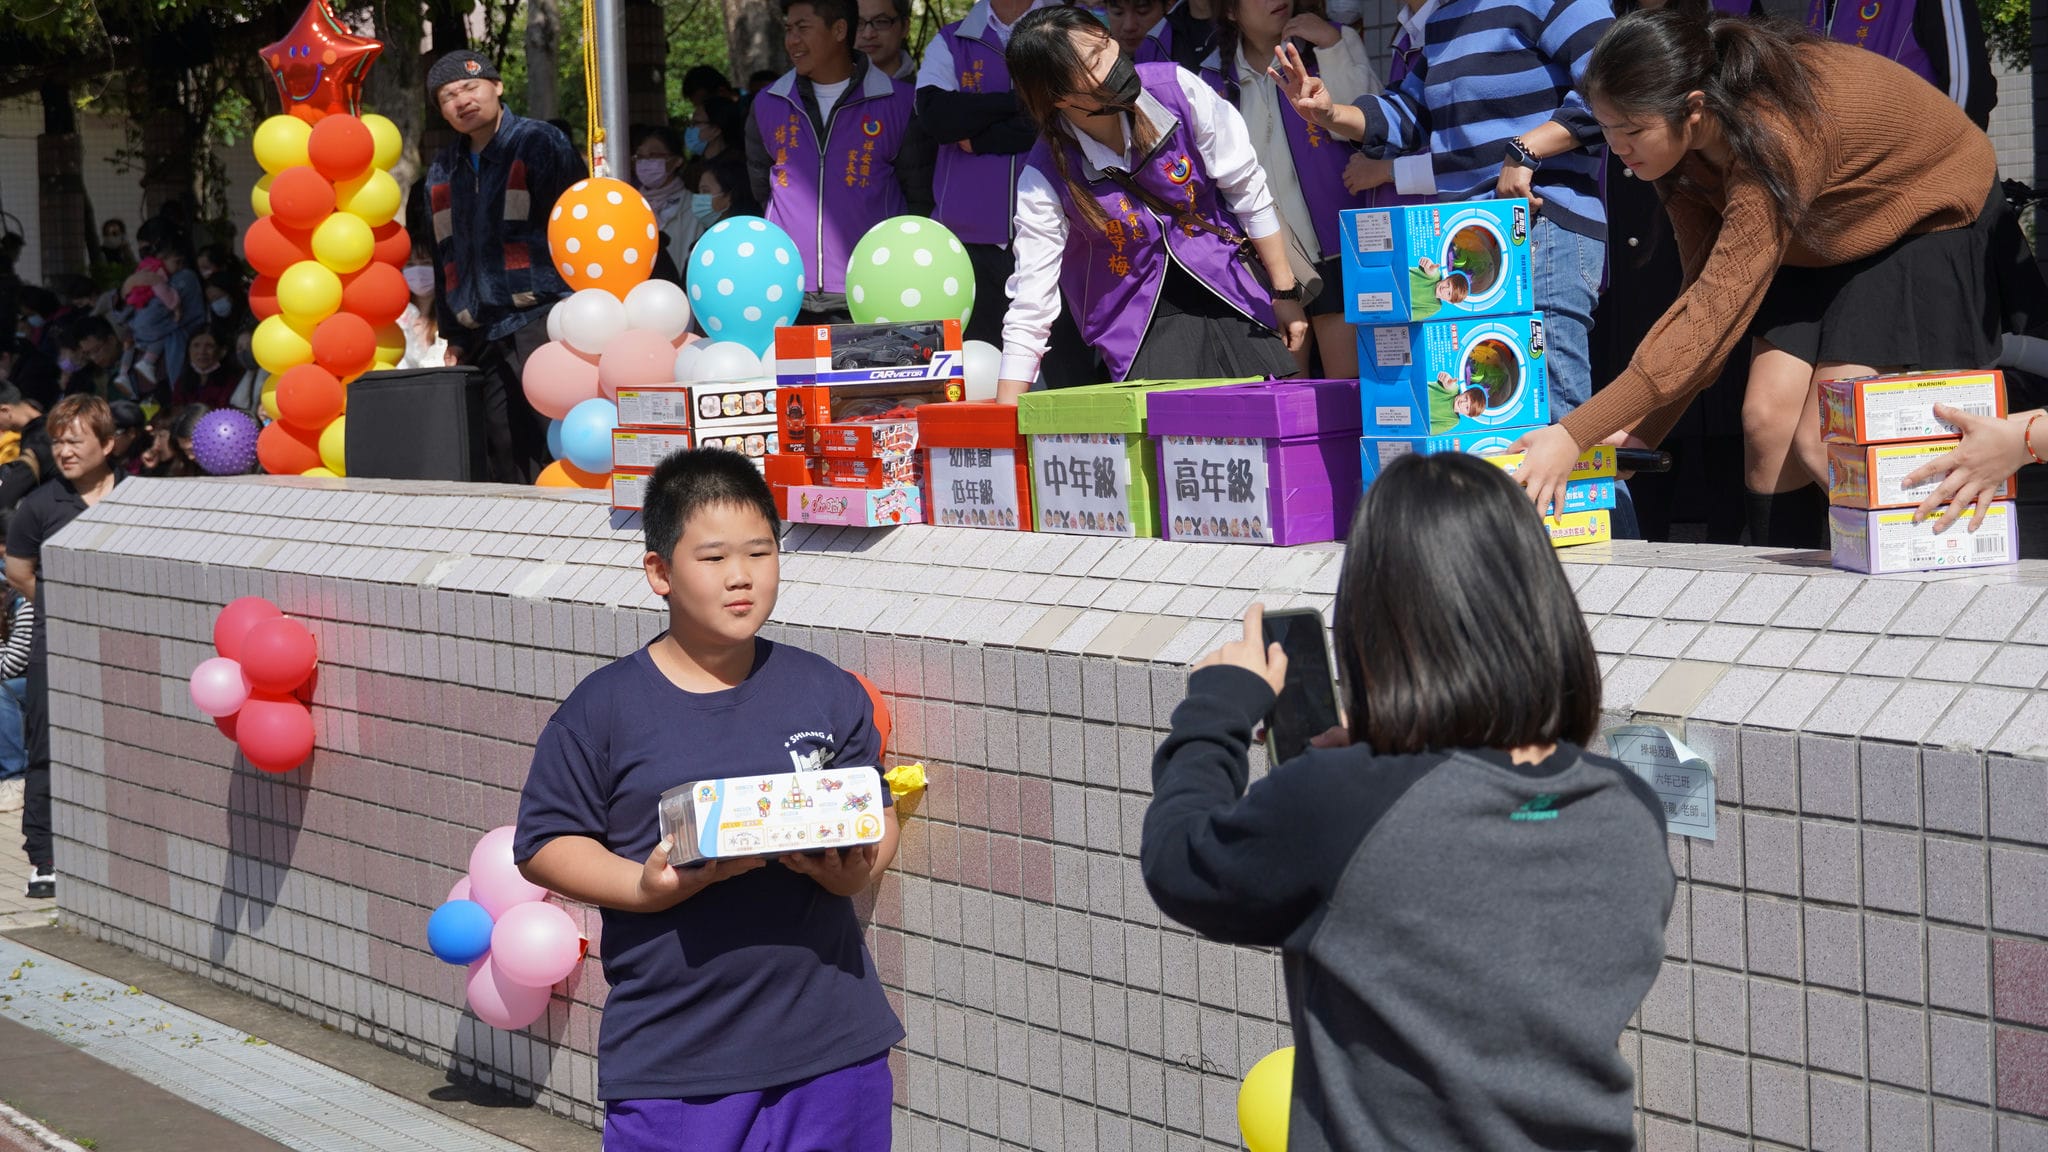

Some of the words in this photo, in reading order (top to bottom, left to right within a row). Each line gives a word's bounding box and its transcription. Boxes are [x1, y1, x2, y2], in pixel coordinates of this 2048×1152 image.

[933, 353, 952, 377] 7
[1916, 380, 1947, 388] WARNING
[1043, 454, 1118, 499] 中年級
[1173, 457, 1256, 503] 高年級
[951, 478, 995, 505] 低年級
[789, 731, 826, 744] SHIANG
